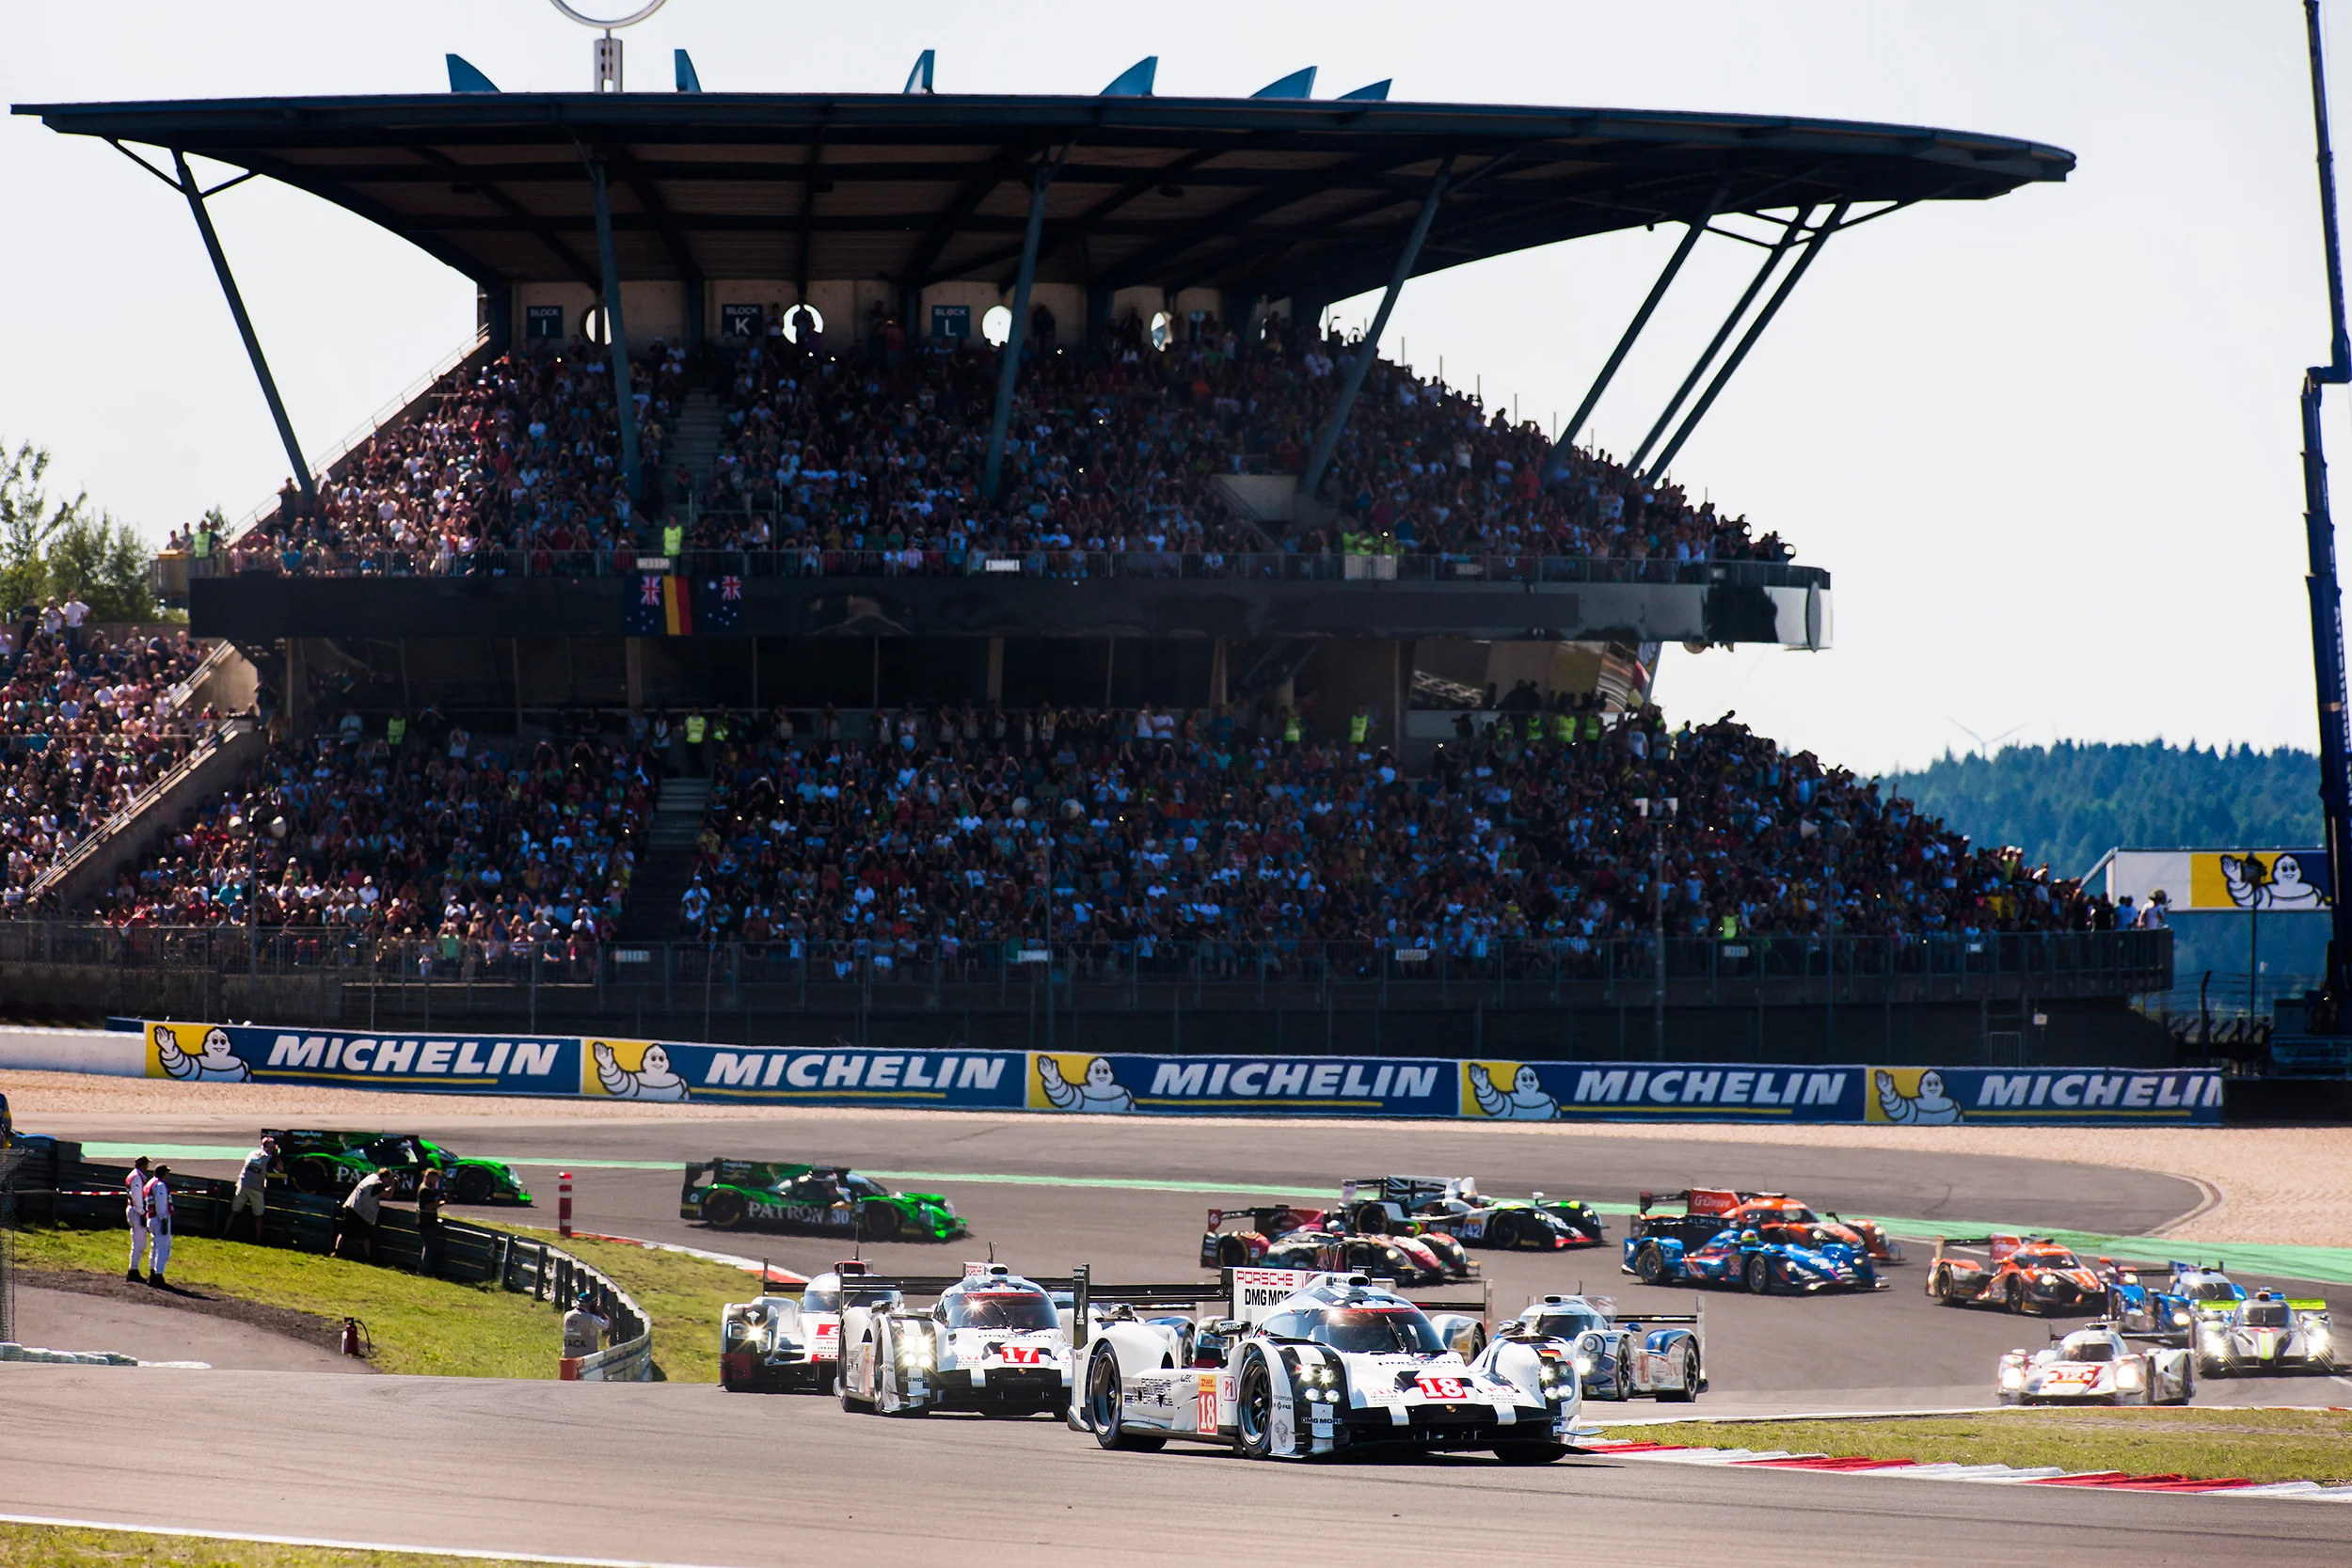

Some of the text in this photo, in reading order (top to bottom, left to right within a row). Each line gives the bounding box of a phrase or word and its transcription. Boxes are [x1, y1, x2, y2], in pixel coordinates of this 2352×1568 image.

[530, 309, 560, 317] BLOCK
[726, 307, 759, 315] BLOCK
[935, 308, 967, 317] BLOCK
[542, 320, 548, 336] I
[734, 317, 752, 336] K
[945, 319, 957, 337] L
[268, 1035, 560, 1076] MICHELIN
[706, 1053, 1006, 1088] MICHELIN
[1152, 1063, 1438, 1096] MICHELIN
[1578, 1070, 1848, 1099] MICHELIN
[832, 1210, 850, 1225] 30
[1236, 1270, 1294, 1287] PORSCHE
[1245, 1289, 1267, 1306] DMG
[1003, 1348, 1037, 1363] 17
[1224, 1381, 1233, 1398] P1
[1419, 1378, 1459, 1398] 18
[1200, 1394, 1216, 1431] 18
